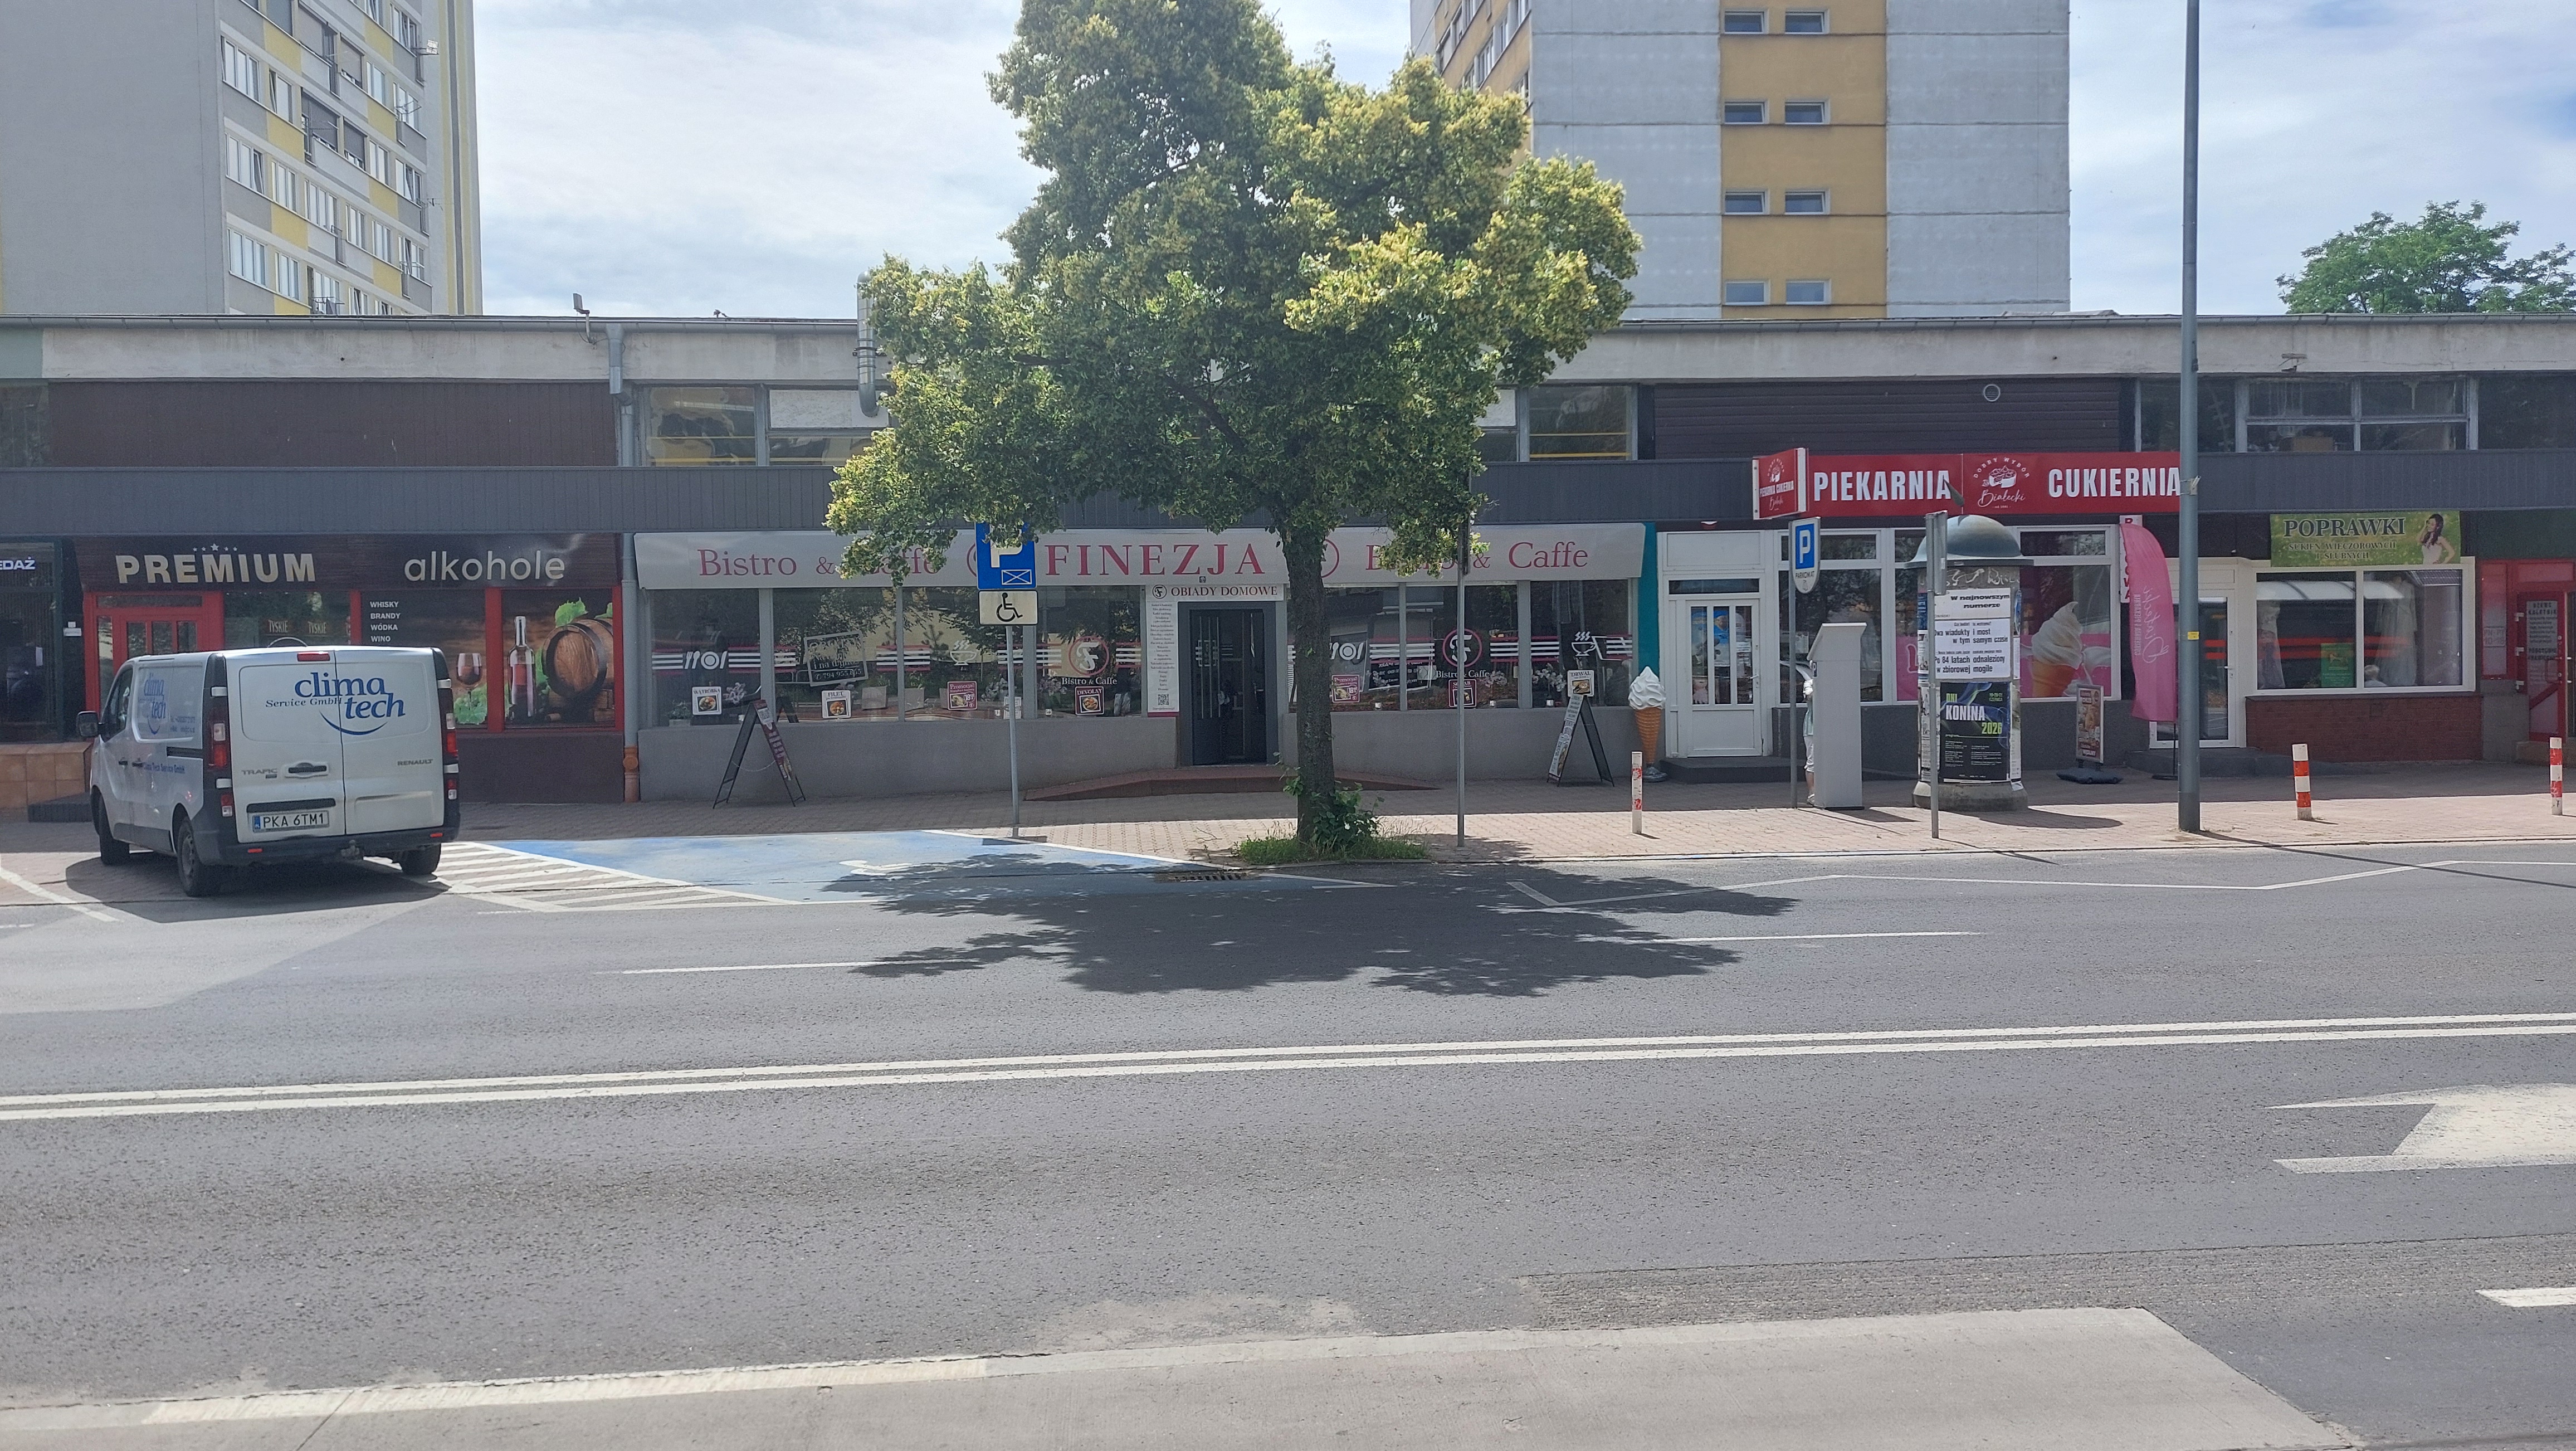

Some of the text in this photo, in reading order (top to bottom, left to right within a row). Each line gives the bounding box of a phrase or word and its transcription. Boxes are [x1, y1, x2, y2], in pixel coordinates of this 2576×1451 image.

[1814, 468, 2180, 501] PIEKARNIA CUKIERNIA
[2284, 518, 2406, 537] POPRAWKI
[1799, 529, 1811, 563] P
[1045, 543, 1265, 576] FINEZJA
[1508, 541, 1588, 568] Caffe
[0, 556, 35, 570] DAŻ
[115, 554, 315, 584] PREMIUM
[404, 550, 565, 581] alkohole
[697, 549, 797, 576] Bistro
[816, 557, 837, 574] &
[1171, 587, 1217, 596] OBIADY
[1221, 586, 1277, 596] DOMOWE
[269, 620, 288, 633] TYSKIE
[308, 622, 326, 634] TYSKIE
[1468, 670, 1490, 678] Caffe
[1943, 665, 1970, 674] zbiorowej
[1973, 665, 1993, 673] mogile
[294, 672, 389, 698] clima
[266, 697, 343, 708] Service GmbH
[1946, 693, 1957, 702] DNI
[344, 693, 406, 719] tech
[1946, 705, 1985, 720] KONINA
[1982, 722, 2002, 734] 2026
[263, 816, 289, 828] PKA
[293, 813, 324, 825] 6TM1
